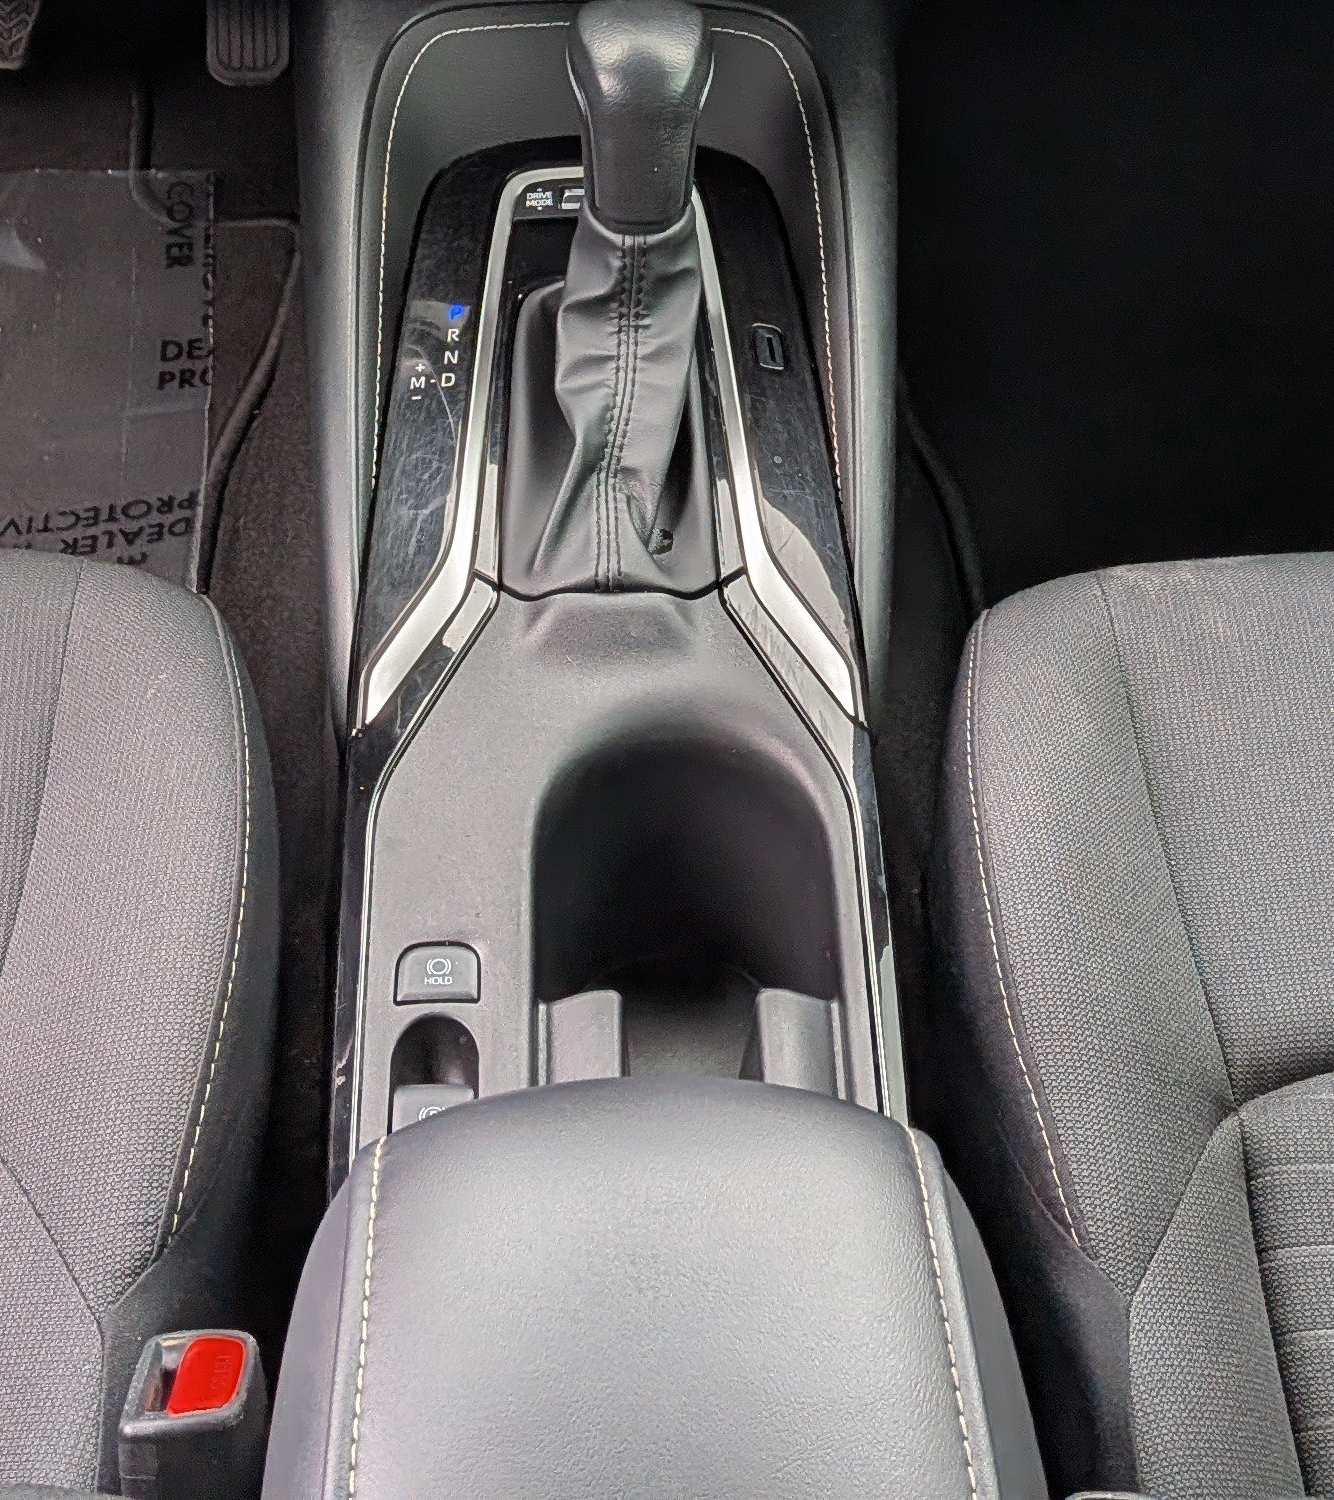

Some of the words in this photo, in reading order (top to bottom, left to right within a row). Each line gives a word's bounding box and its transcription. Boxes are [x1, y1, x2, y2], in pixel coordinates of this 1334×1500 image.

[527, 192, 552, 200] DRIVE
[526, 199, 553, 207] MODE
[167, 181, 194, 269] COVER
[449, 304, 463, 320] P
[447, 329, 459, 342] R
[444, 351, 459, 364] N
[410, 376, 425, 389] M
[441, 373, 455, 387] D
[58, 515, 193, 557] DEALER
[424, 977, 453, 985] HOLD
